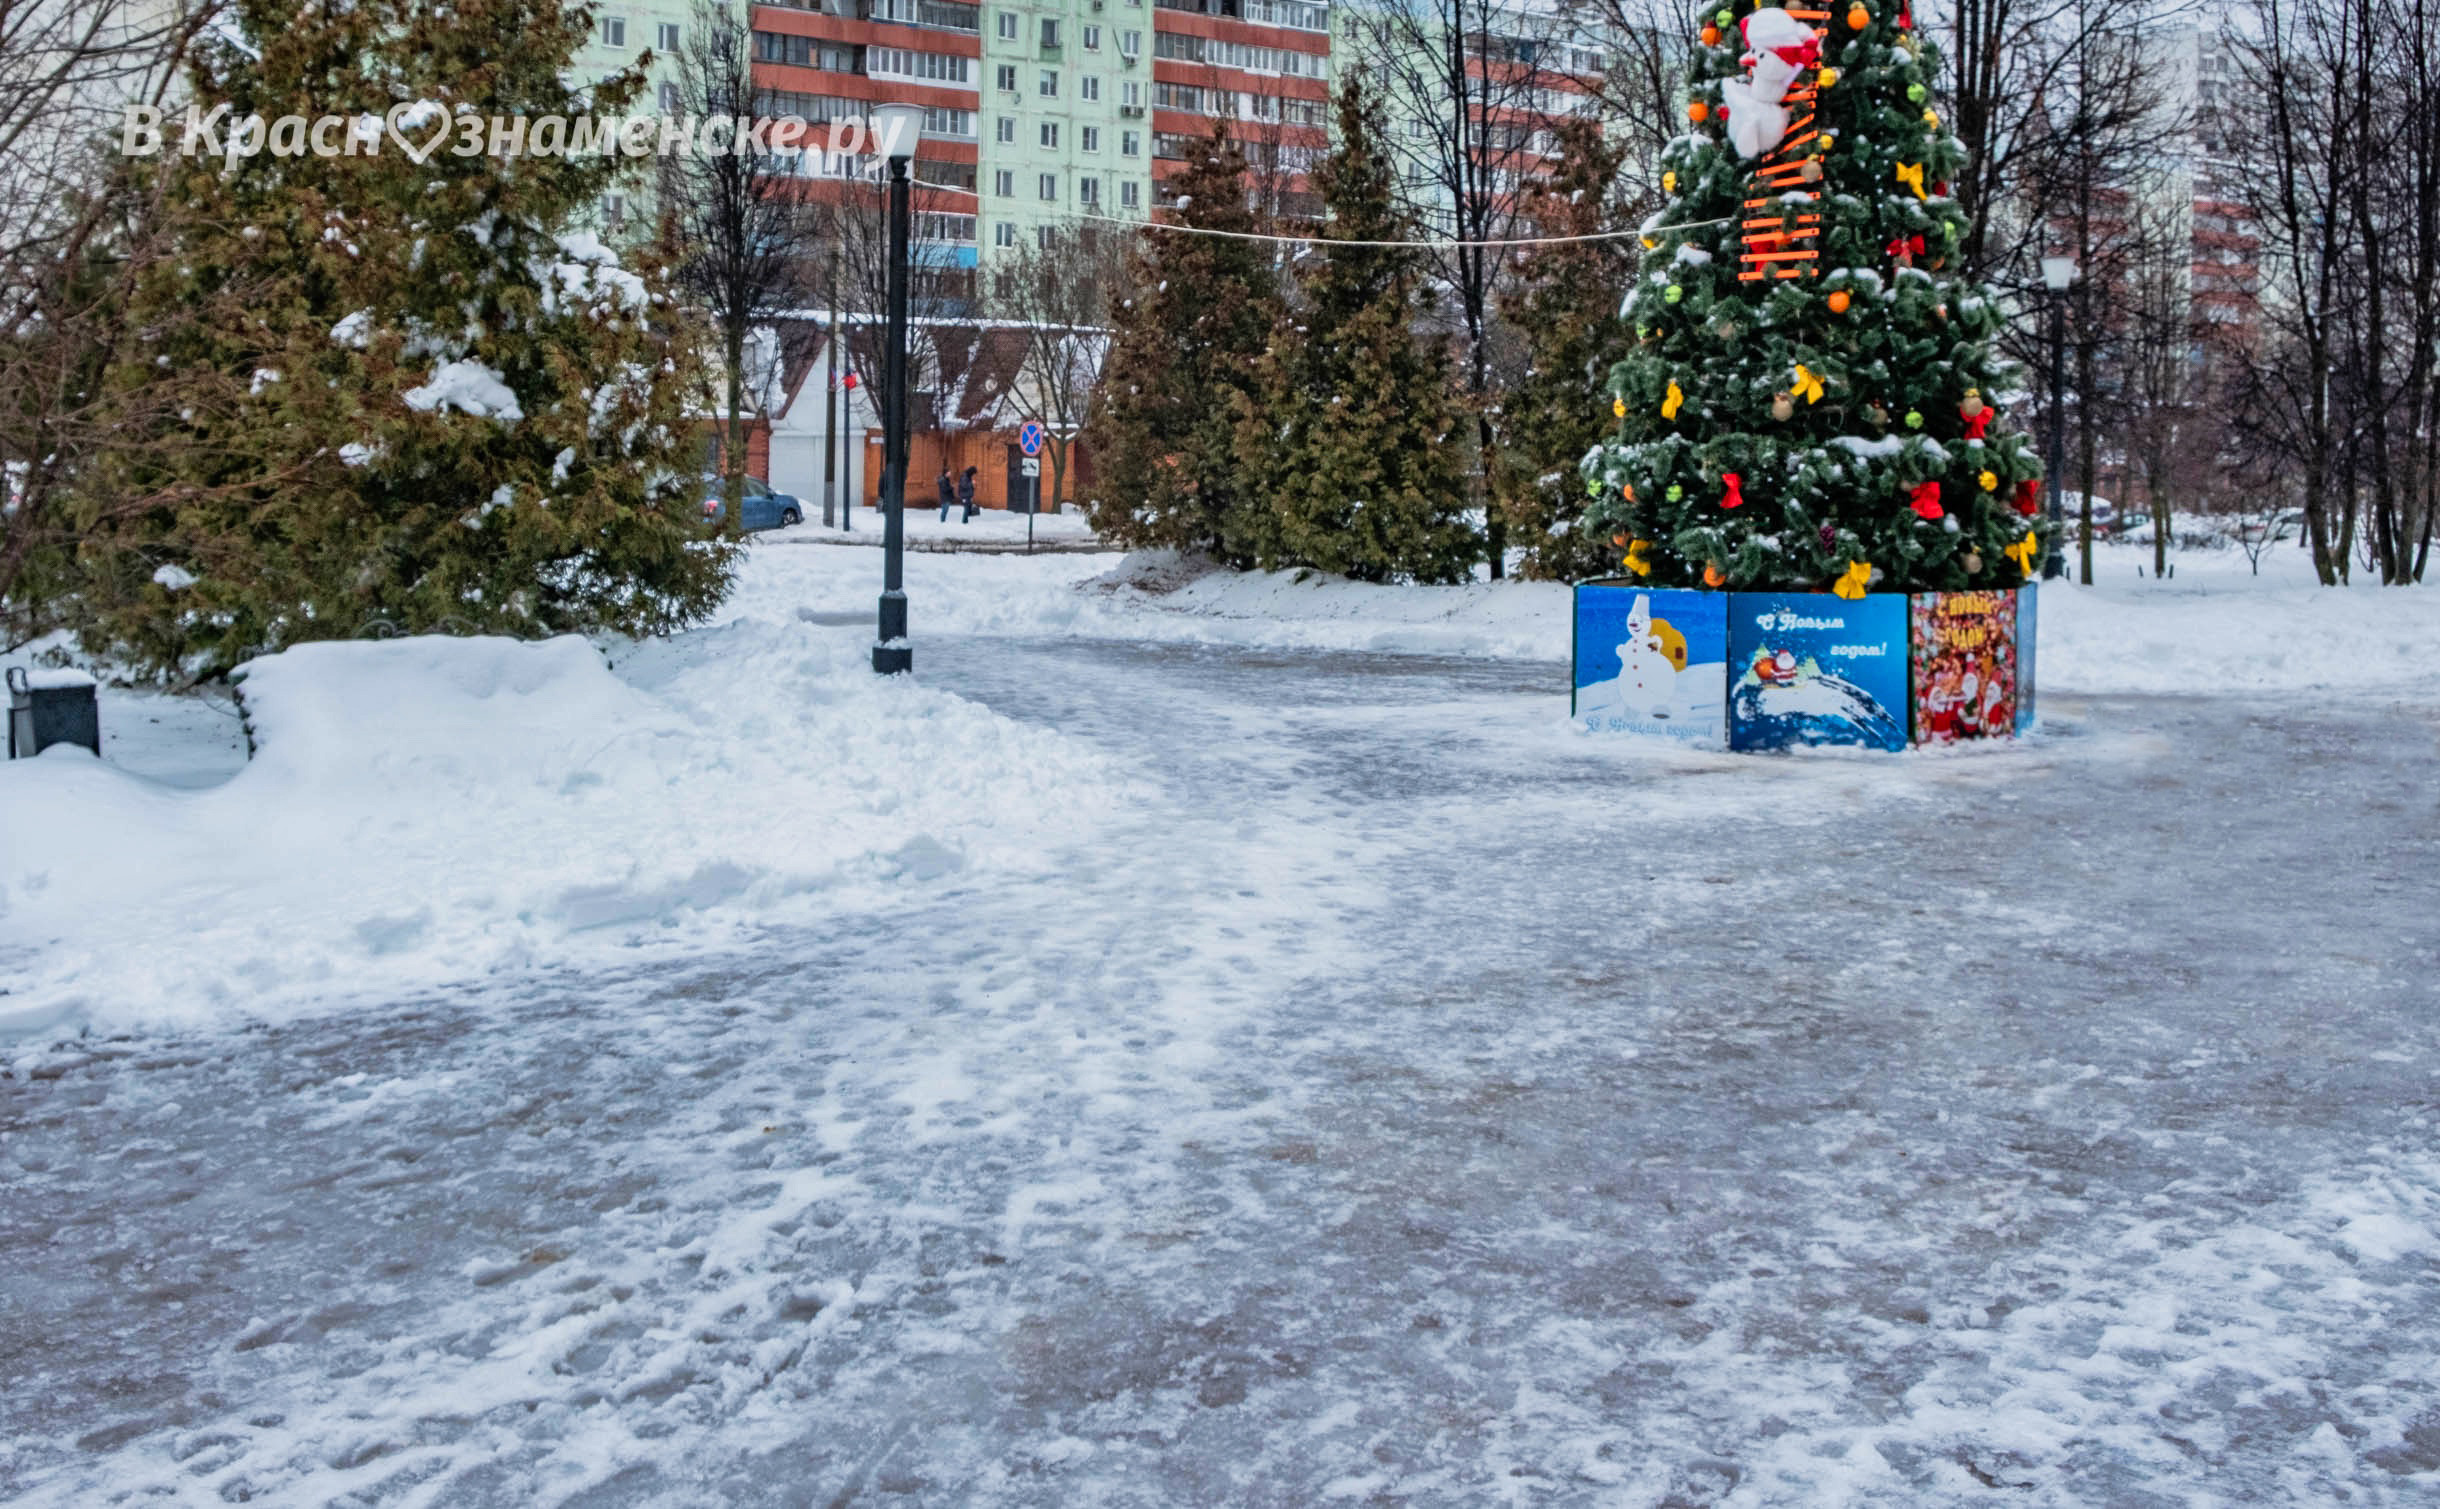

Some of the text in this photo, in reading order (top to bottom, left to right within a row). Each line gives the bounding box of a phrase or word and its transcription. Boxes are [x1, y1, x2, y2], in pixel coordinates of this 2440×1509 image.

[1756, 613, 1845, 632] С Новым
[1830, 641, 1888, 660] годом!
